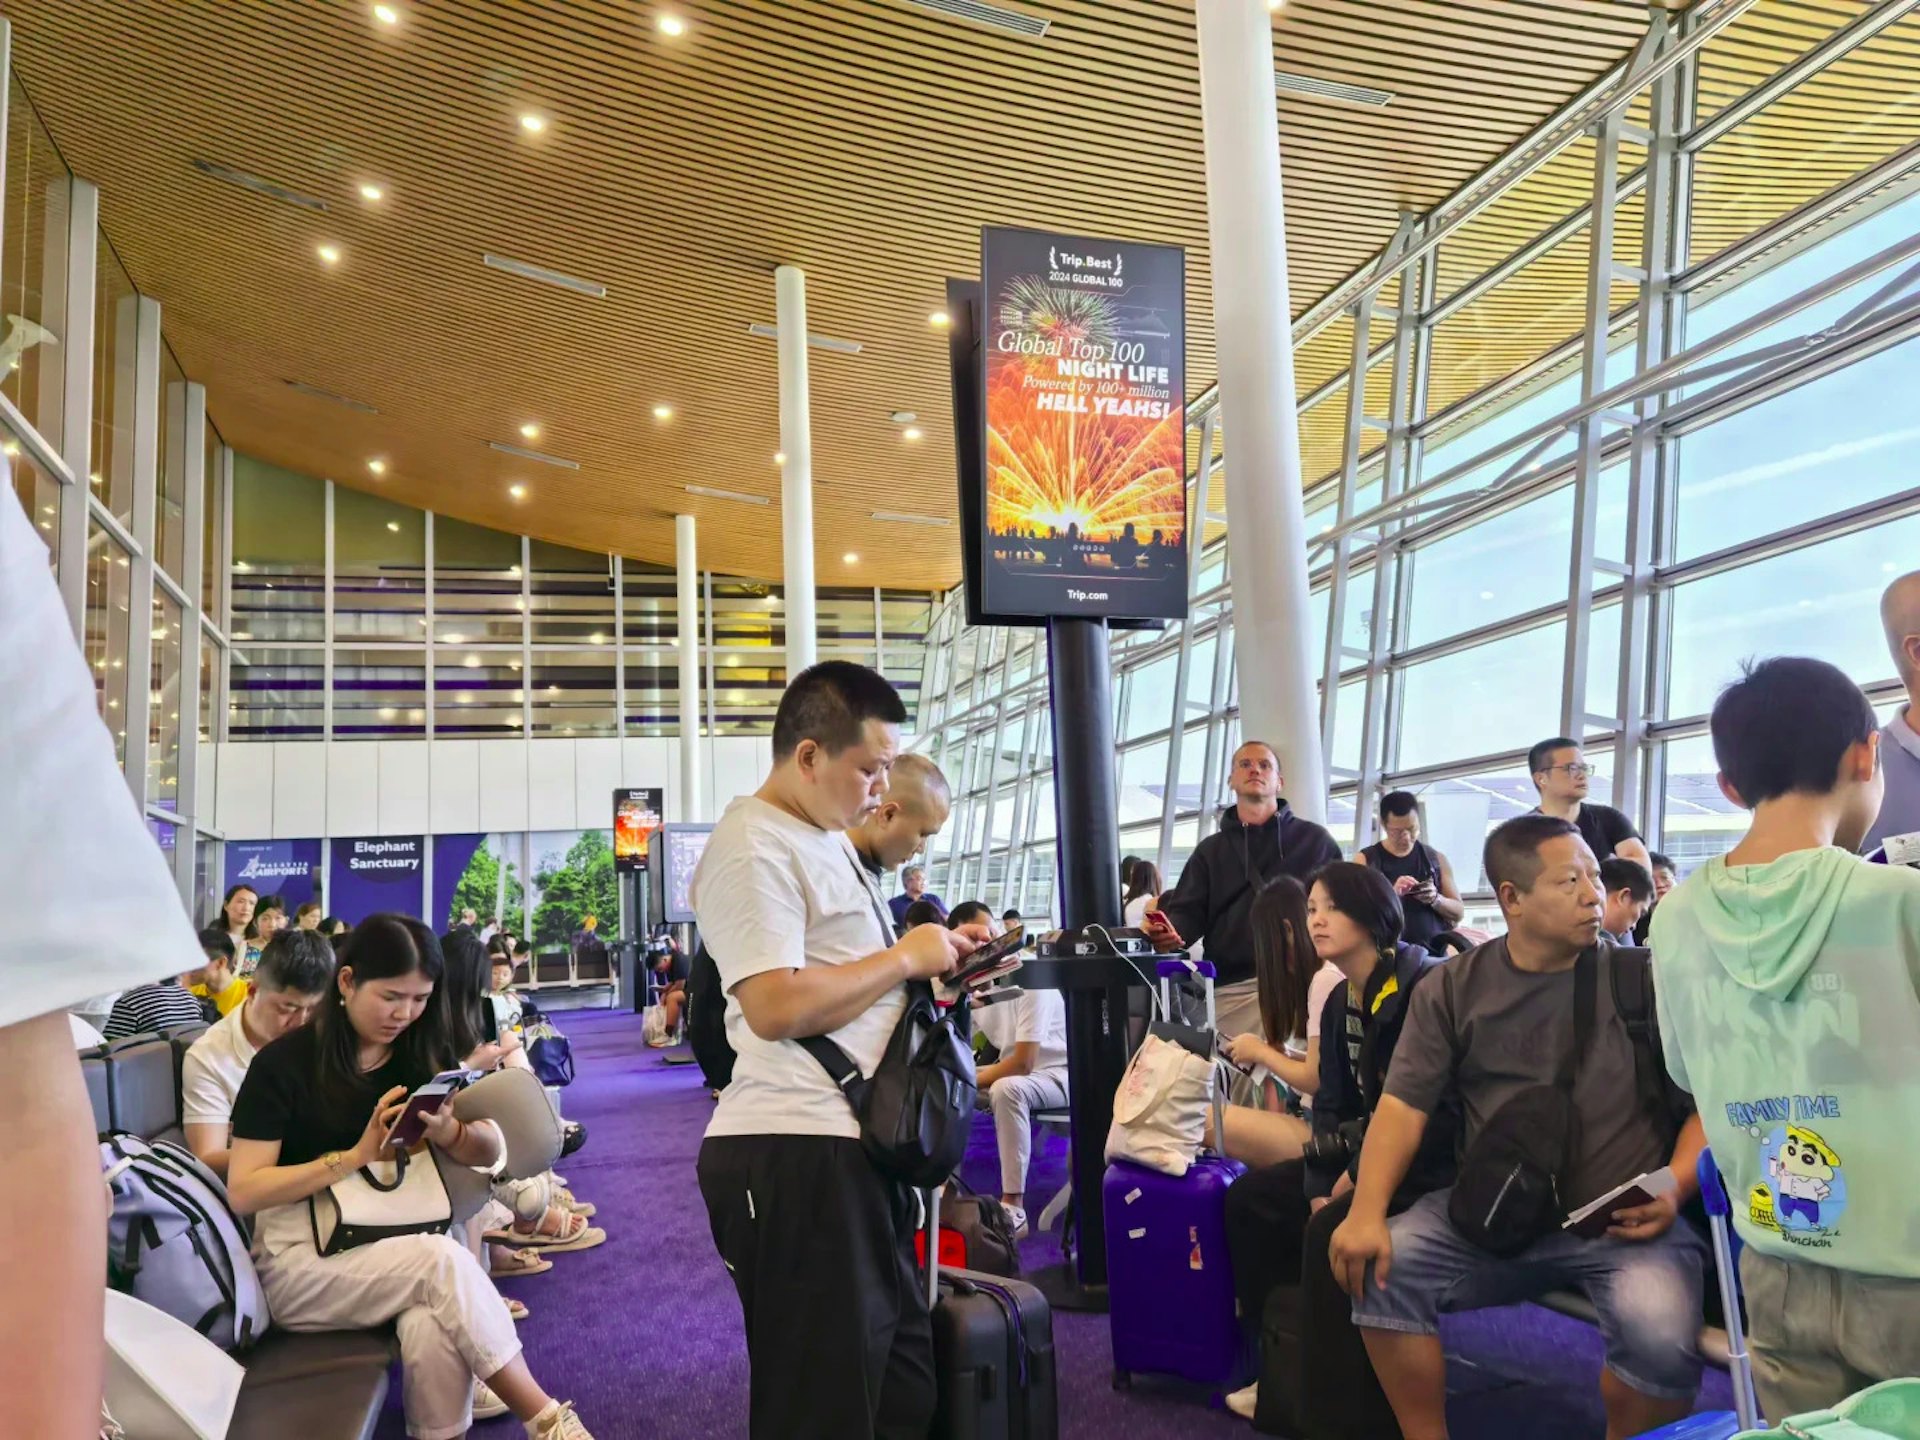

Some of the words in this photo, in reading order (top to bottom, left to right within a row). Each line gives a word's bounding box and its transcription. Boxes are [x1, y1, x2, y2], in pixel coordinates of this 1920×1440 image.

[1060, 253, 1112, 269] Trip.Best
[1049, 271, 1070, 282] 2024
[1072, 273, 1107, 286] GLOBAL
[1108, 277, 1123, 287] 100
[998, 330, 1062, 356] Global
[1069, 337, 1104, 364] Top
[1109, 342, 1145, 363] 100
[1058, 360, 1124, 380] NIGHT
[1128, 366, 1169, 384] LIFE
[1023, 376, 1075, 391] Powered
[1078, 380, 1094, 395] by
[1096, 382, 1125, 394] 100+
[1128, 385, 1170, 399] million
[1036, 393, 1088, 412] HELL
[1094, 397, 1170, 419] YEAHS!
[1067, 589, 1109, 602] Trip.com
[354, 841, 416, 855] Elephant
[256, 867, 308, 876] AIRPORTS
[350, 858, 419, 870] Sanctuary
[1725, 1097, 1790, 1126] FAMILY
[1792, 1095, 1841, 1121] TIME
